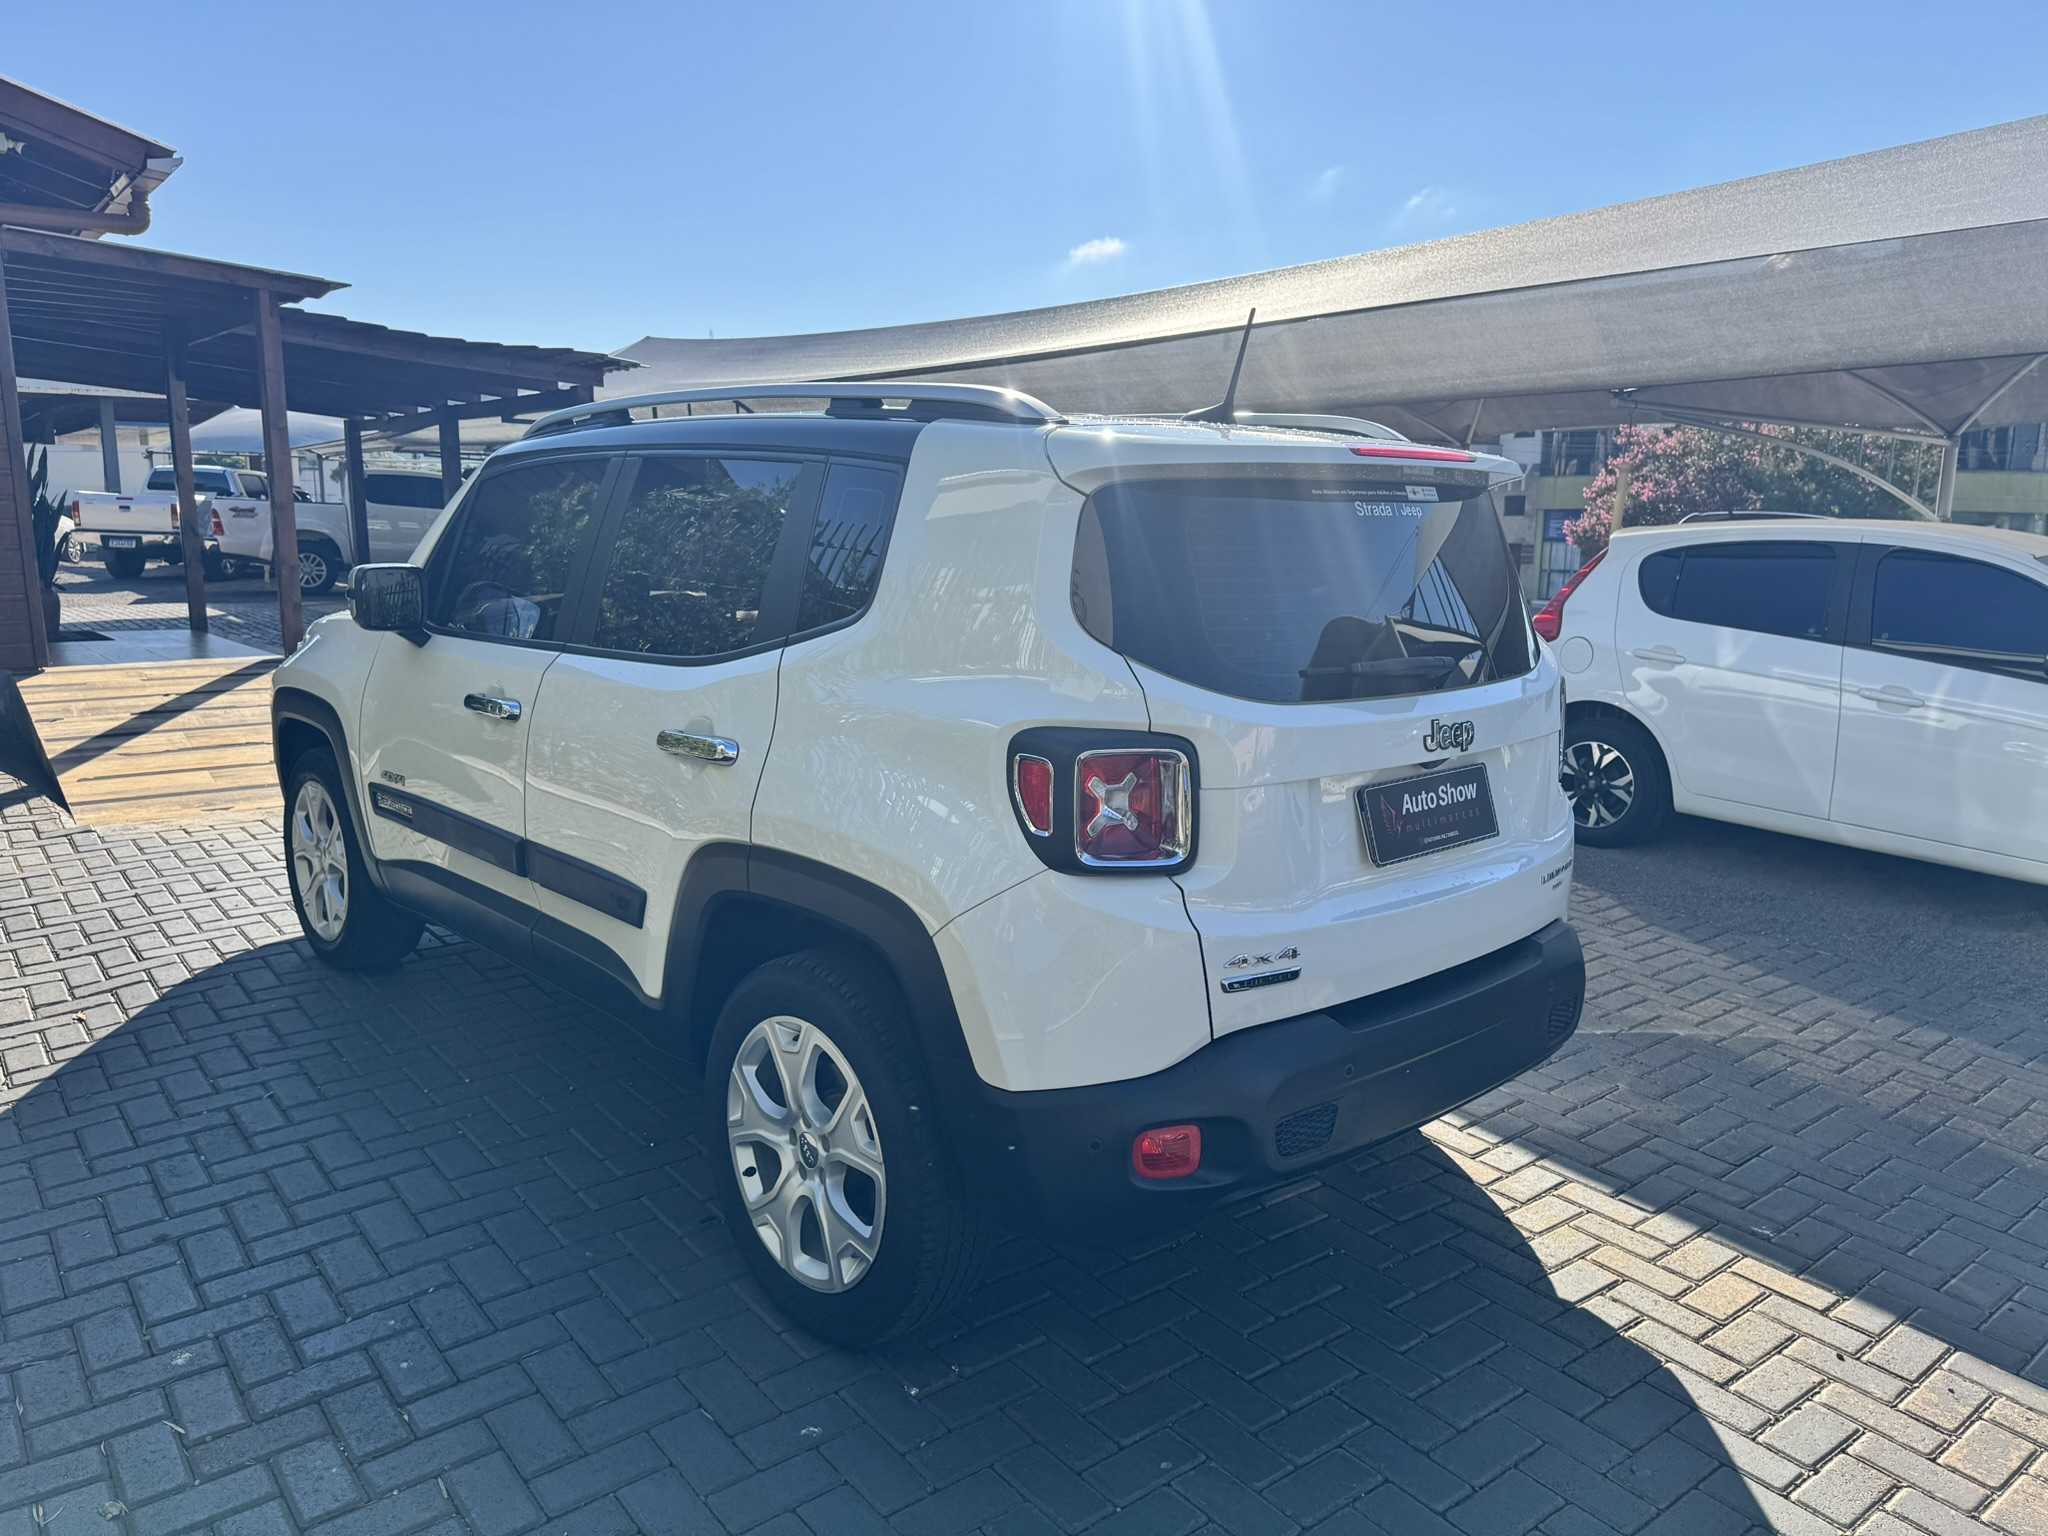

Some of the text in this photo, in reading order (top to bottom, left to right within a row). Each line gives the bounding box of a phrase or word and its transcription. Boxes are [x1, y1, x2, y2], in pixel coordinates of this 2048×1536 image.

[1354, 501, 1393, 517] Strada
[1401, 503, 1422, 519] Jeep
[1424, 719, 1475, 751] Jeep
[1402, 782, 1477, 815] Auto Show
